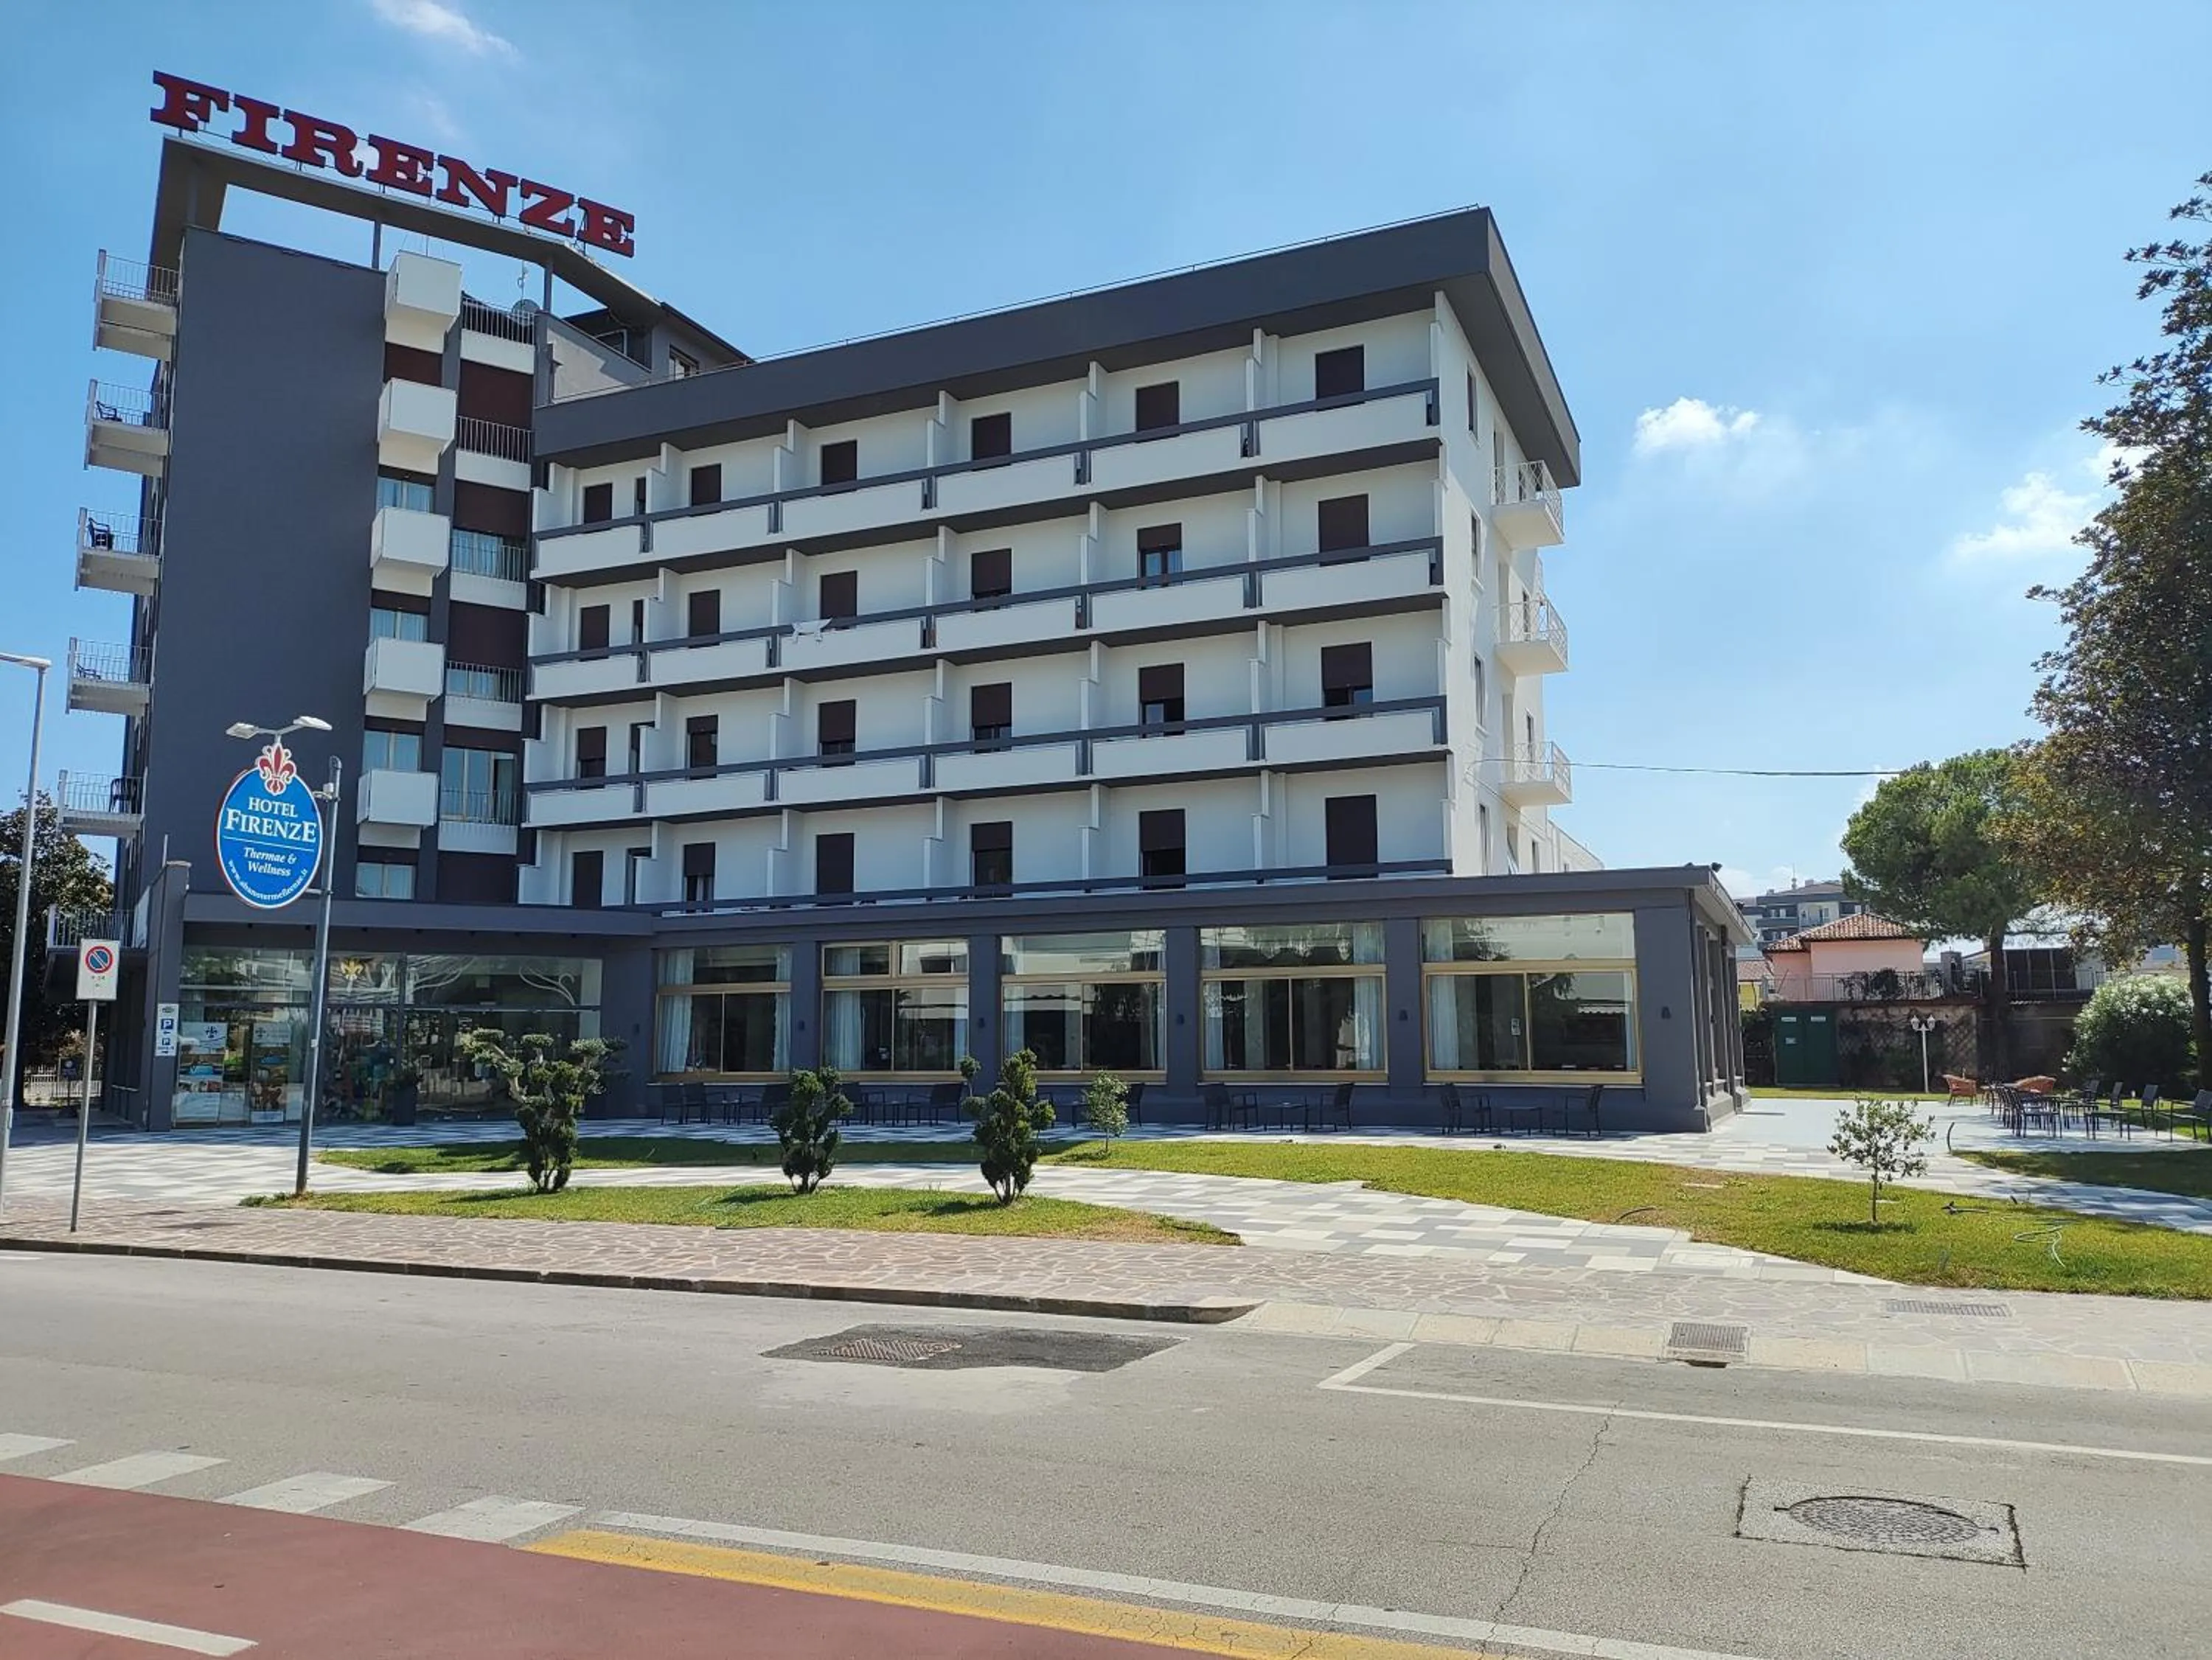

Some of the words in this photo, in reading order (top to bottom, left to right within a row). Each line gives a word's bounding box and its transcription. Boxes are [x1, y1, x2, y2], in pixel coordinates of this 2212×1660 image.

[150, 69, 635, 258] FIRENZE
[248, 797, 298, 817] HOTEL
[226, 808, 316, 843] FIRENZE
[244, 848, 286, 862] Thermae
[287, 853, 297, 865] &
[248, 861, 291, 876] Wellness
